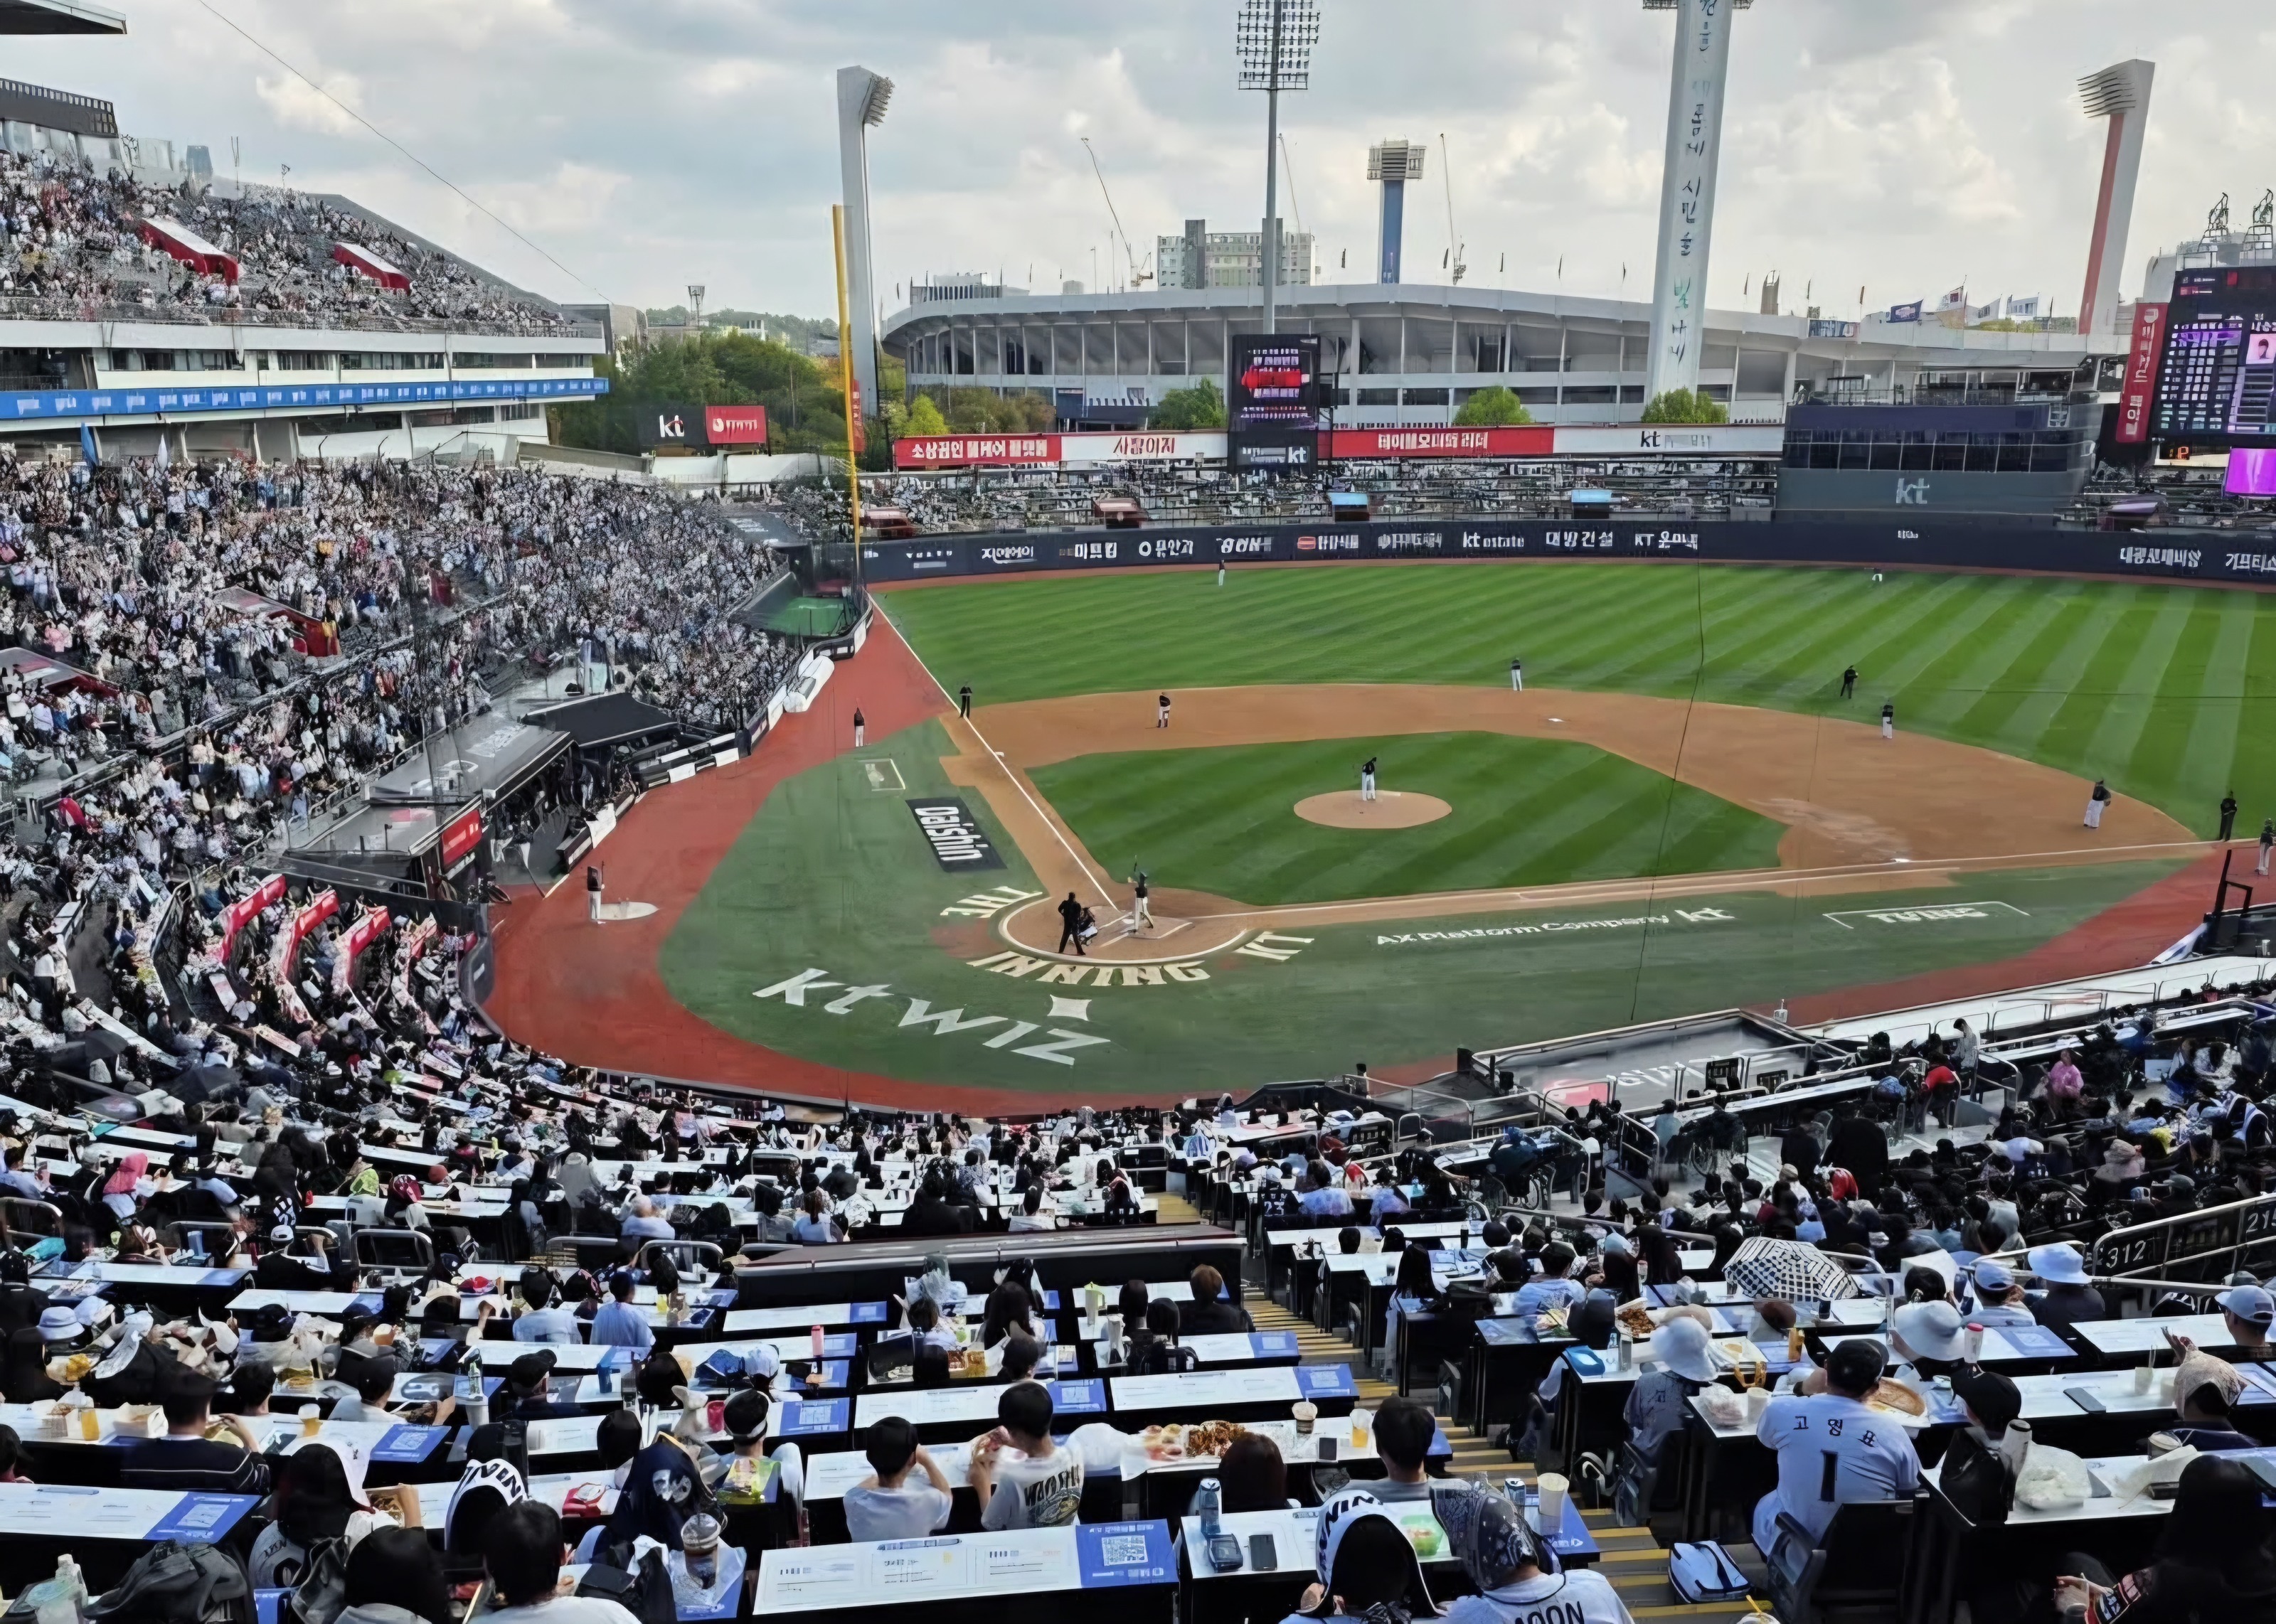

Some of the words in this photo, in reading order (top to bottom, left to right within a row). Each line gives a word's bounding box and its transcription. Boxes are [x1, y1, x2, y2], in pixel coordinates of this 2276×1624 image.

[1640, 430, 1661, 448] kt
[1288, 447, 1307, 464] kt
[1895, 478, 1930, 504] kt
[1462, 531, 1481, 548] kt
[752, 968, 895, 1015] kt
[898, 995, 1112, 1066] wiz
